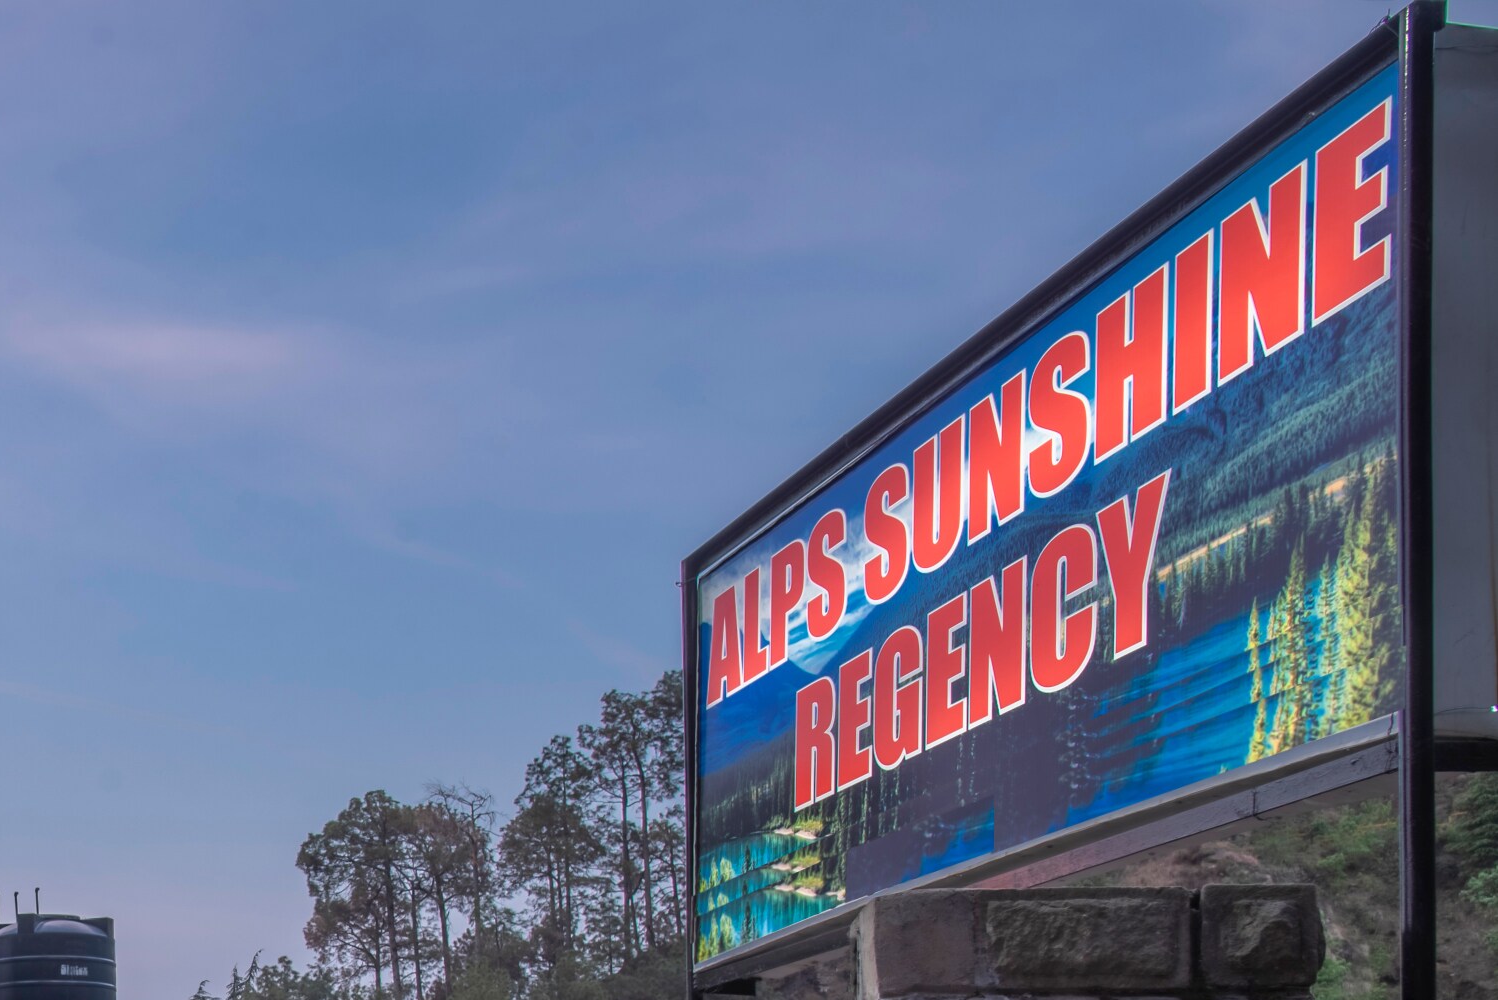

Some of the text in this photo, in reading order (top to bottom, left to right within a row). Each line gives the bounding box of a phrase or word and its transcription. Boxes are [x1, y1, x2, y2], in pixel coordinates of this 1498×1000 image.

[707, 97, 1393, 710] ALPS SUNSHINE
[794, 469, 1172, 812] REGENCY
